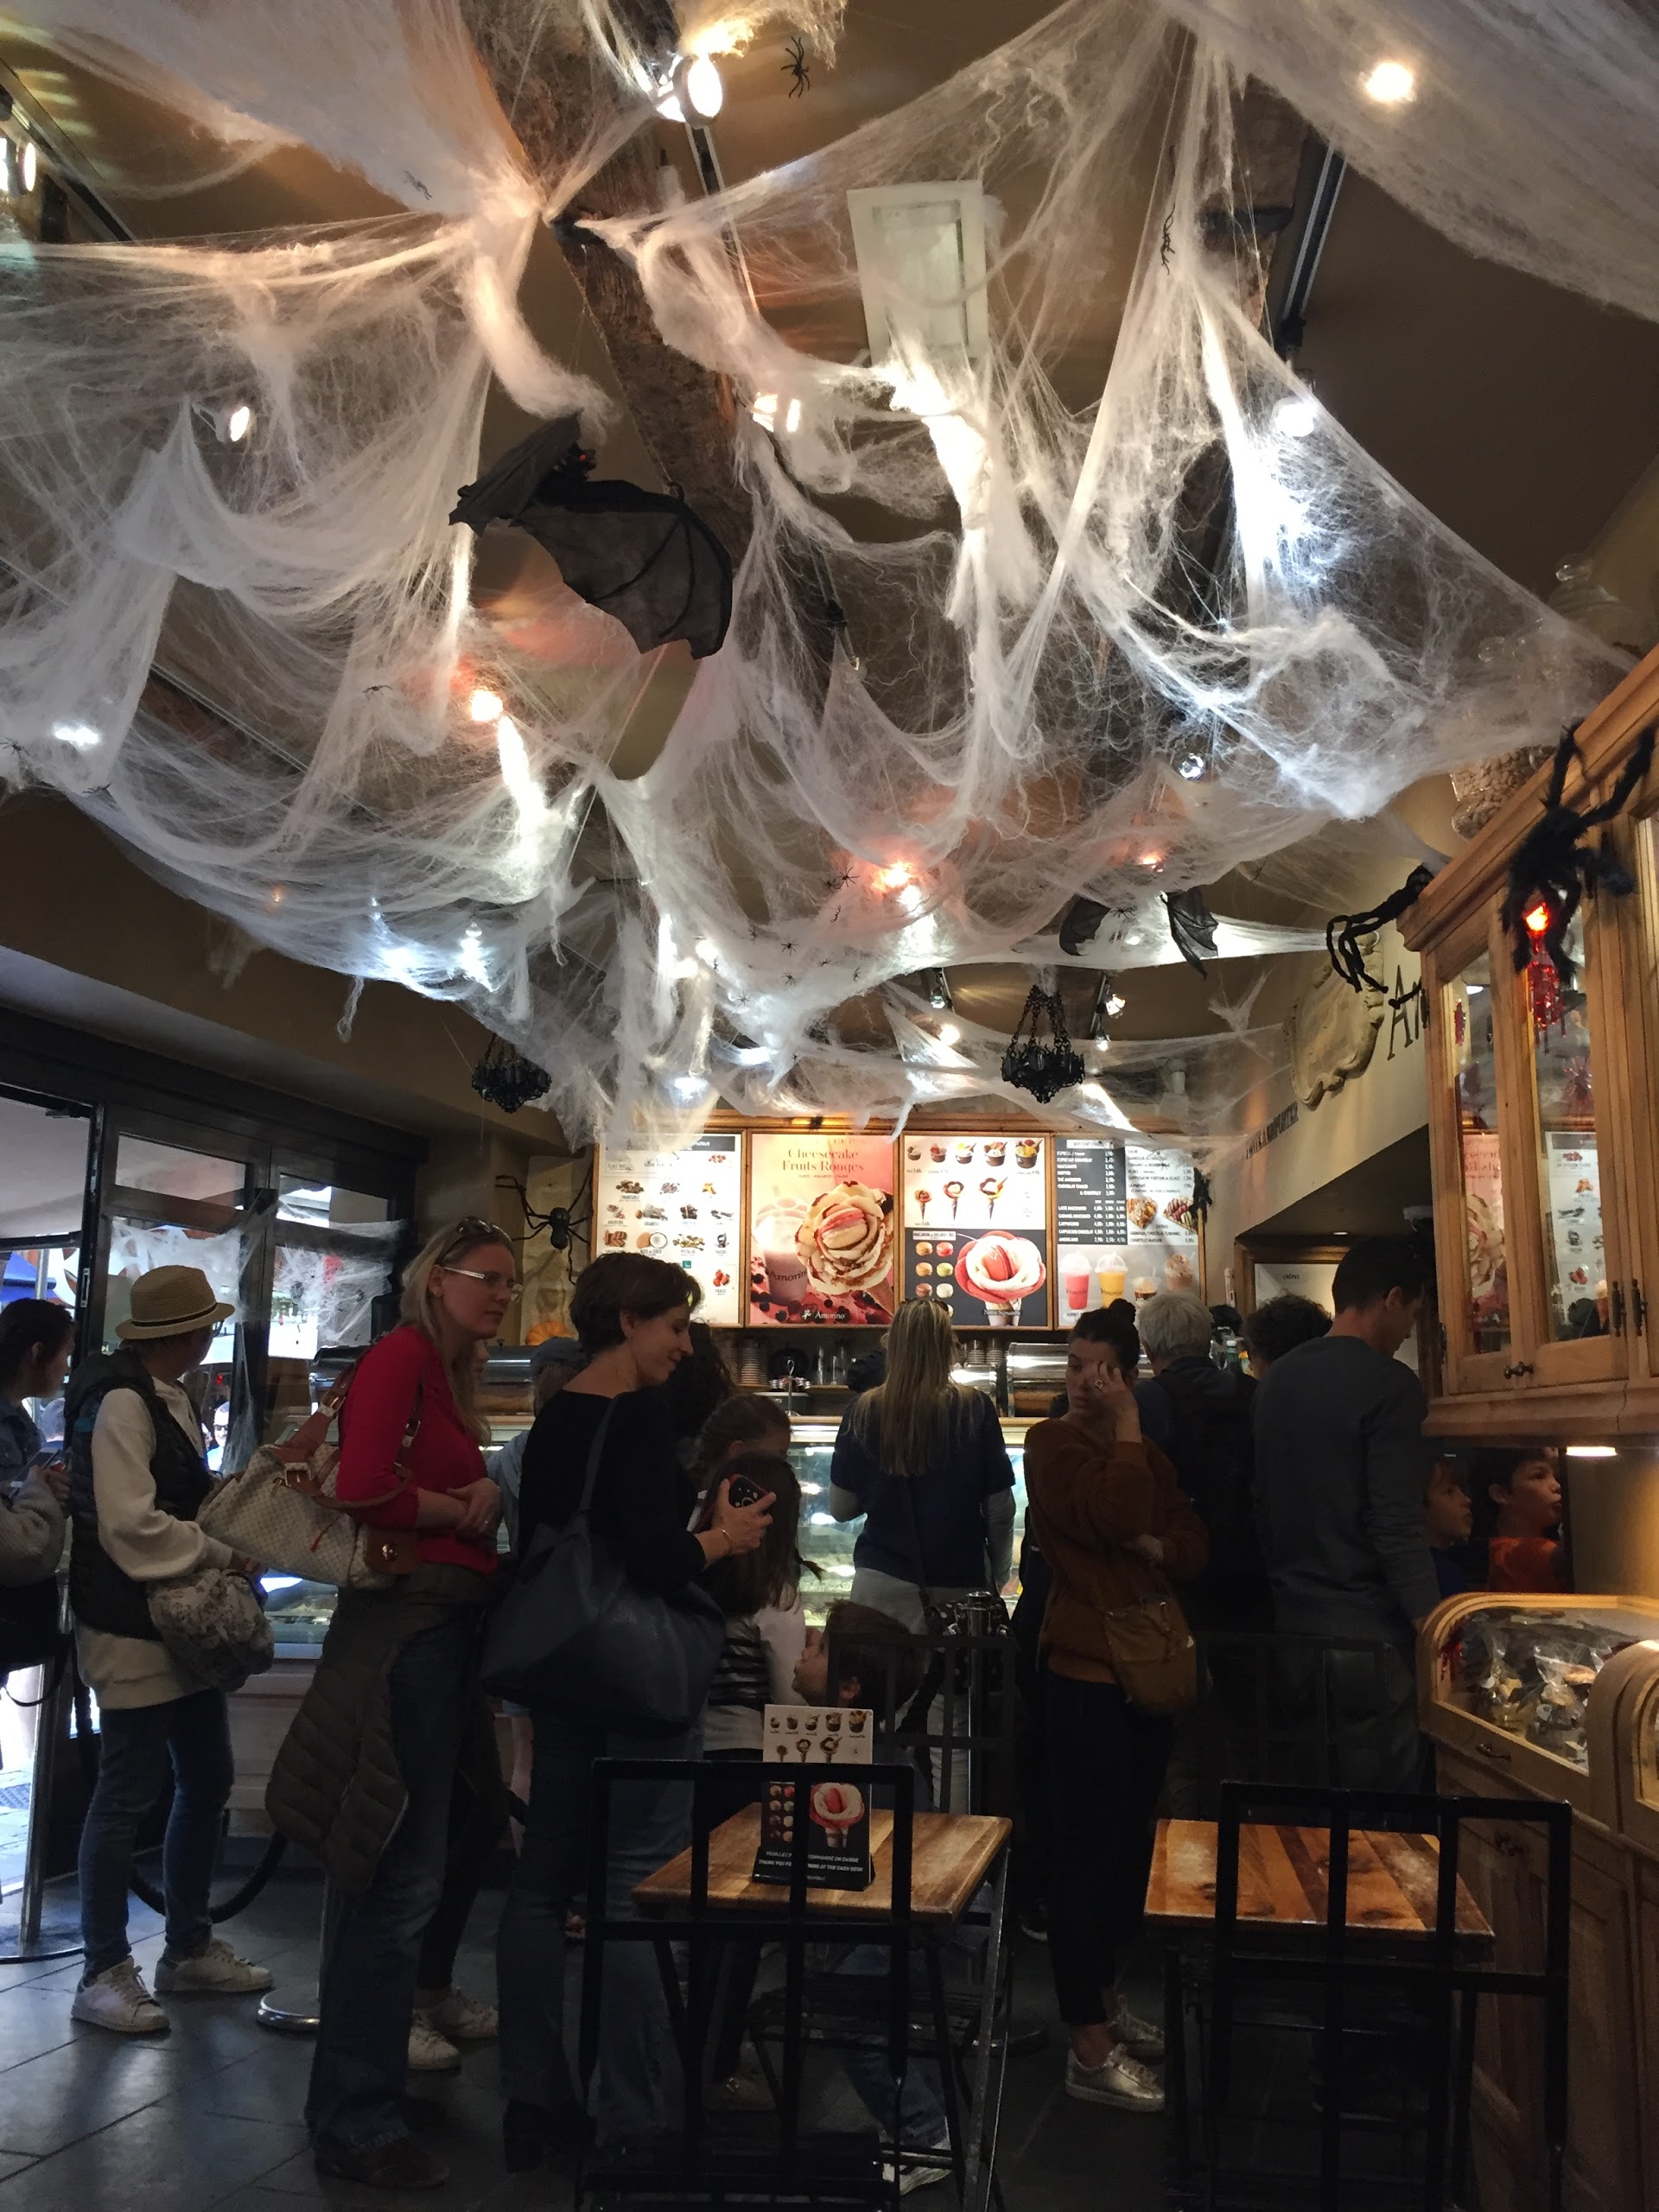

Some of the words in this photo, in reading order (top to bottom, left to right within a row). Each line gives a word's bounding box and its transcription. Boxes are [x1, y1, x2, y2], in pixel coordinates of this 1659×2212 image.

[788, 1148, 859, 1159] Cheesecake
[783, 1160, 817, 1171] Fruits
[820, 1160, 865, 1174] Rouges
[769, 1271, 808, 1281] Amorin
[815, 1311, 846, 1319] Amorino
